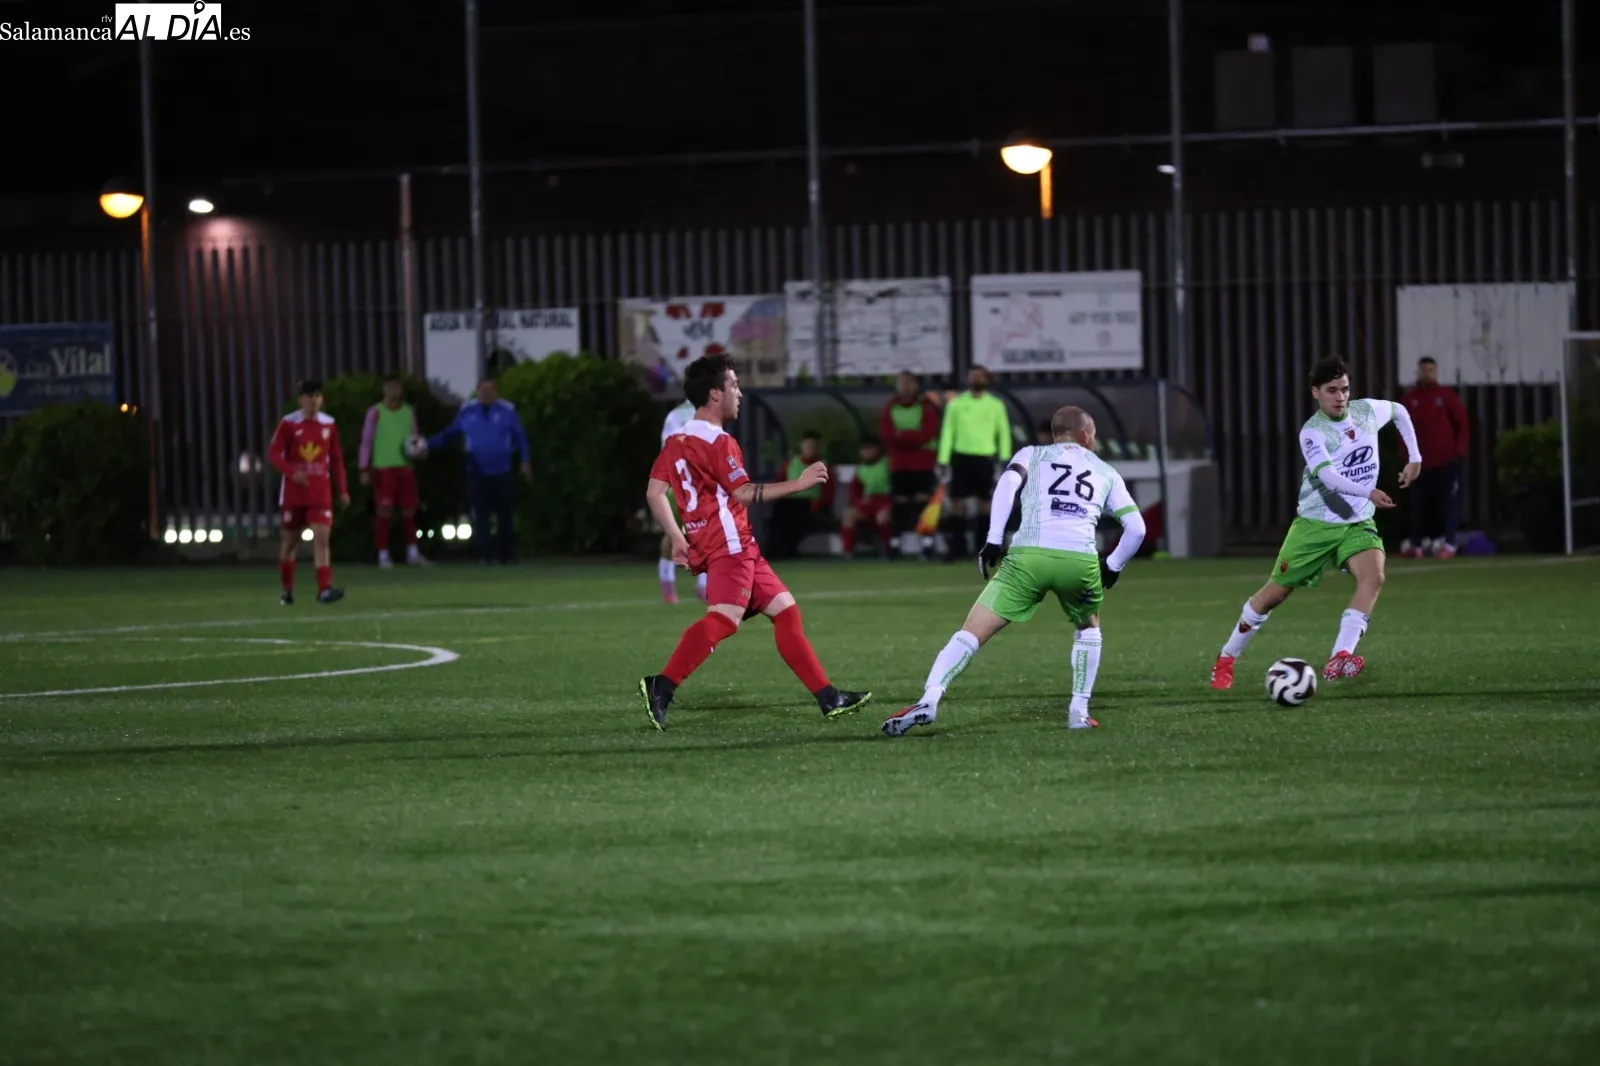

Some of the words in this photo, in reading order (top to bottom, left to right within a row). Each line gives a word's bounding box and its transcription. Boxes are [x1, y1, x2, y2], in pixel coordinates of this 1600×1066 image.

[48, 343, 112, 378] Vital
[675, 458, 698, 513] 3
[1048, 462, 1095, 502] 26
